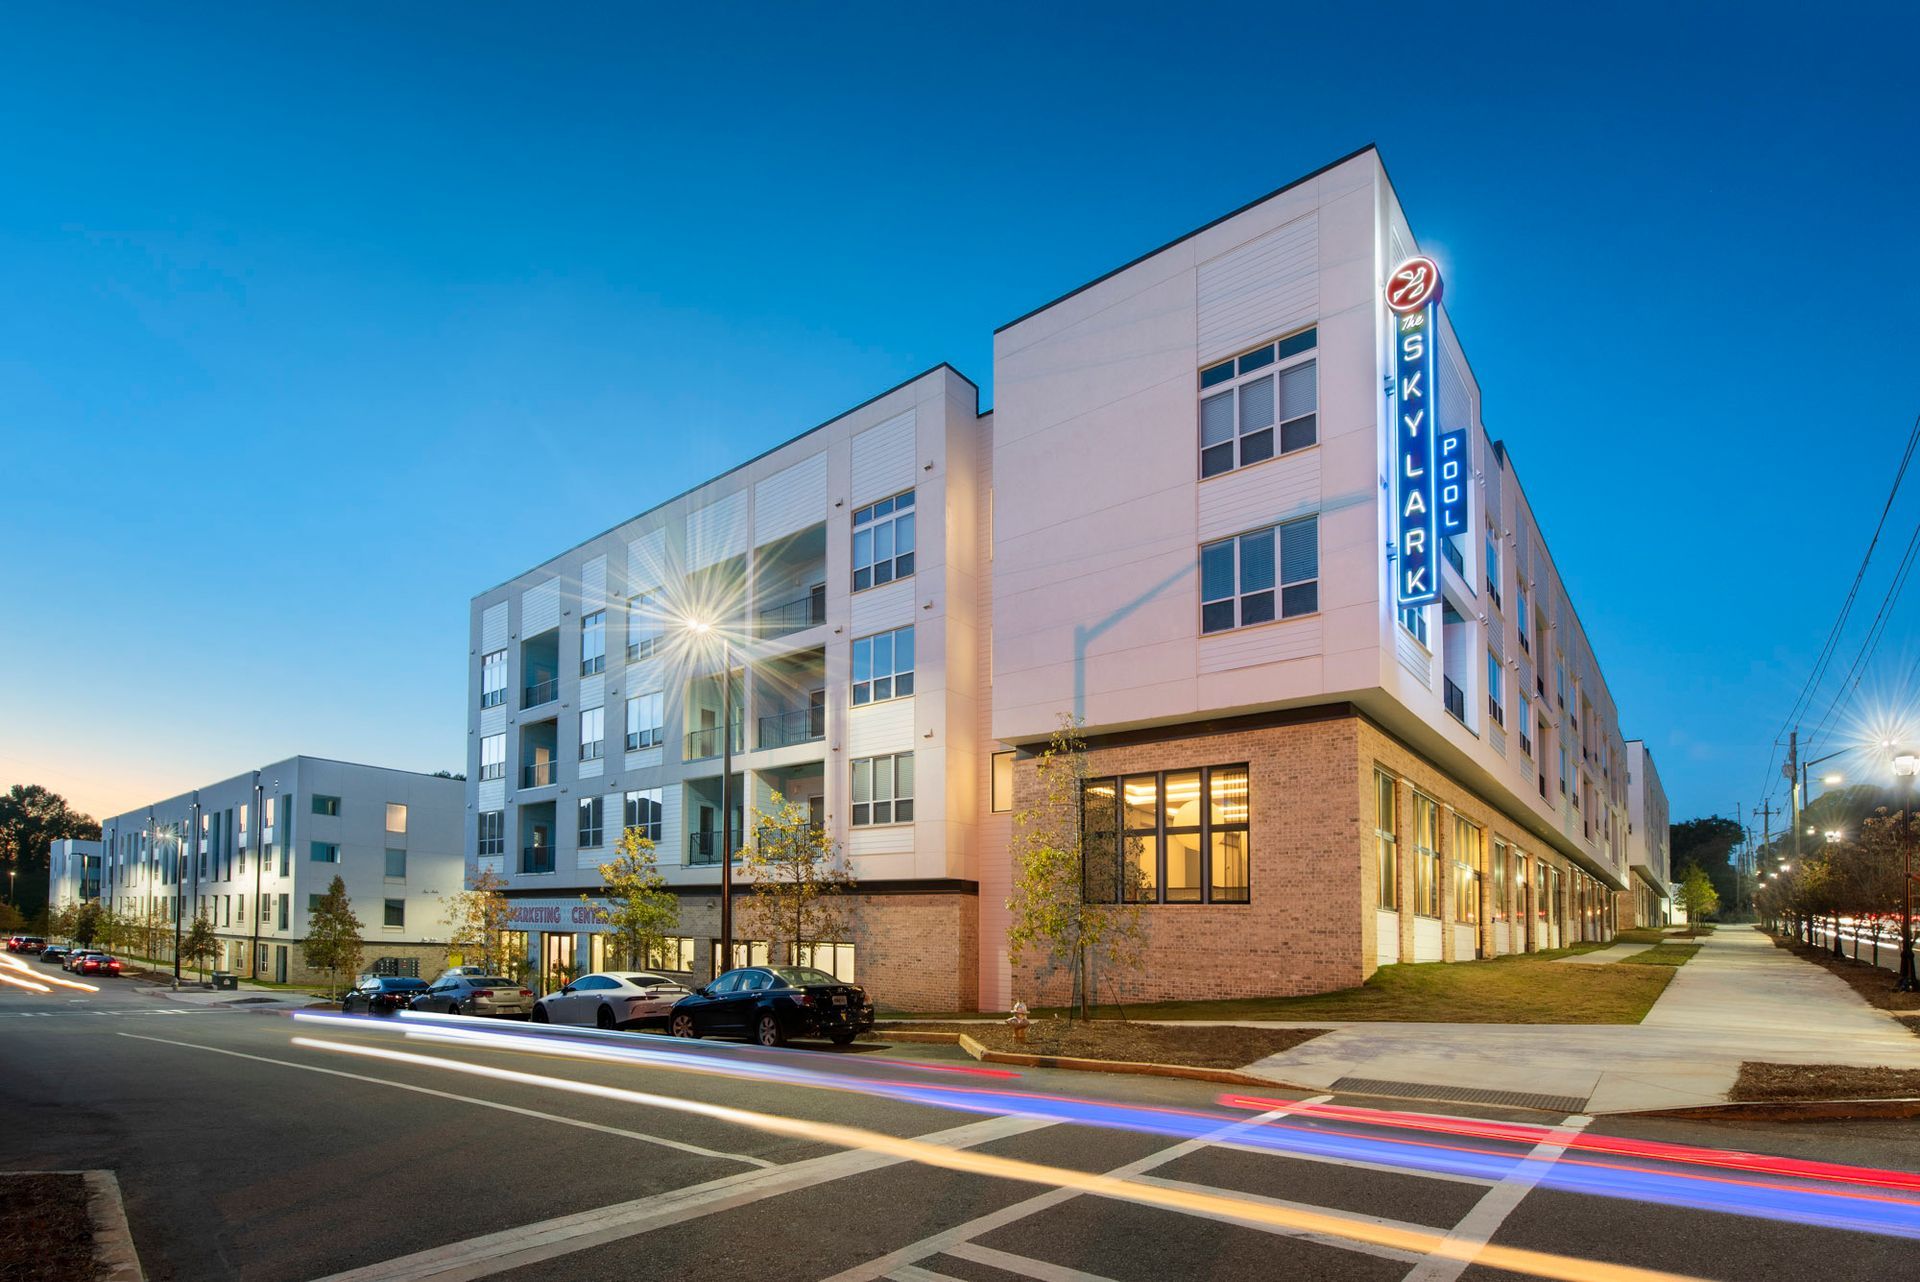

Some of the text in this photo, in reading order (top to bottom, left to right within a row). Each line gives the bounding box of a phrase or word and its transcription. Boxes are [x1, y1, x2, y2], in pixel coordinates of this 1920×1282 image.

[1402, 314, 1424, 331] The
[1402, 333, 1426, 594] SKYLARK
[1443, 437, 1459, 527] POOL
